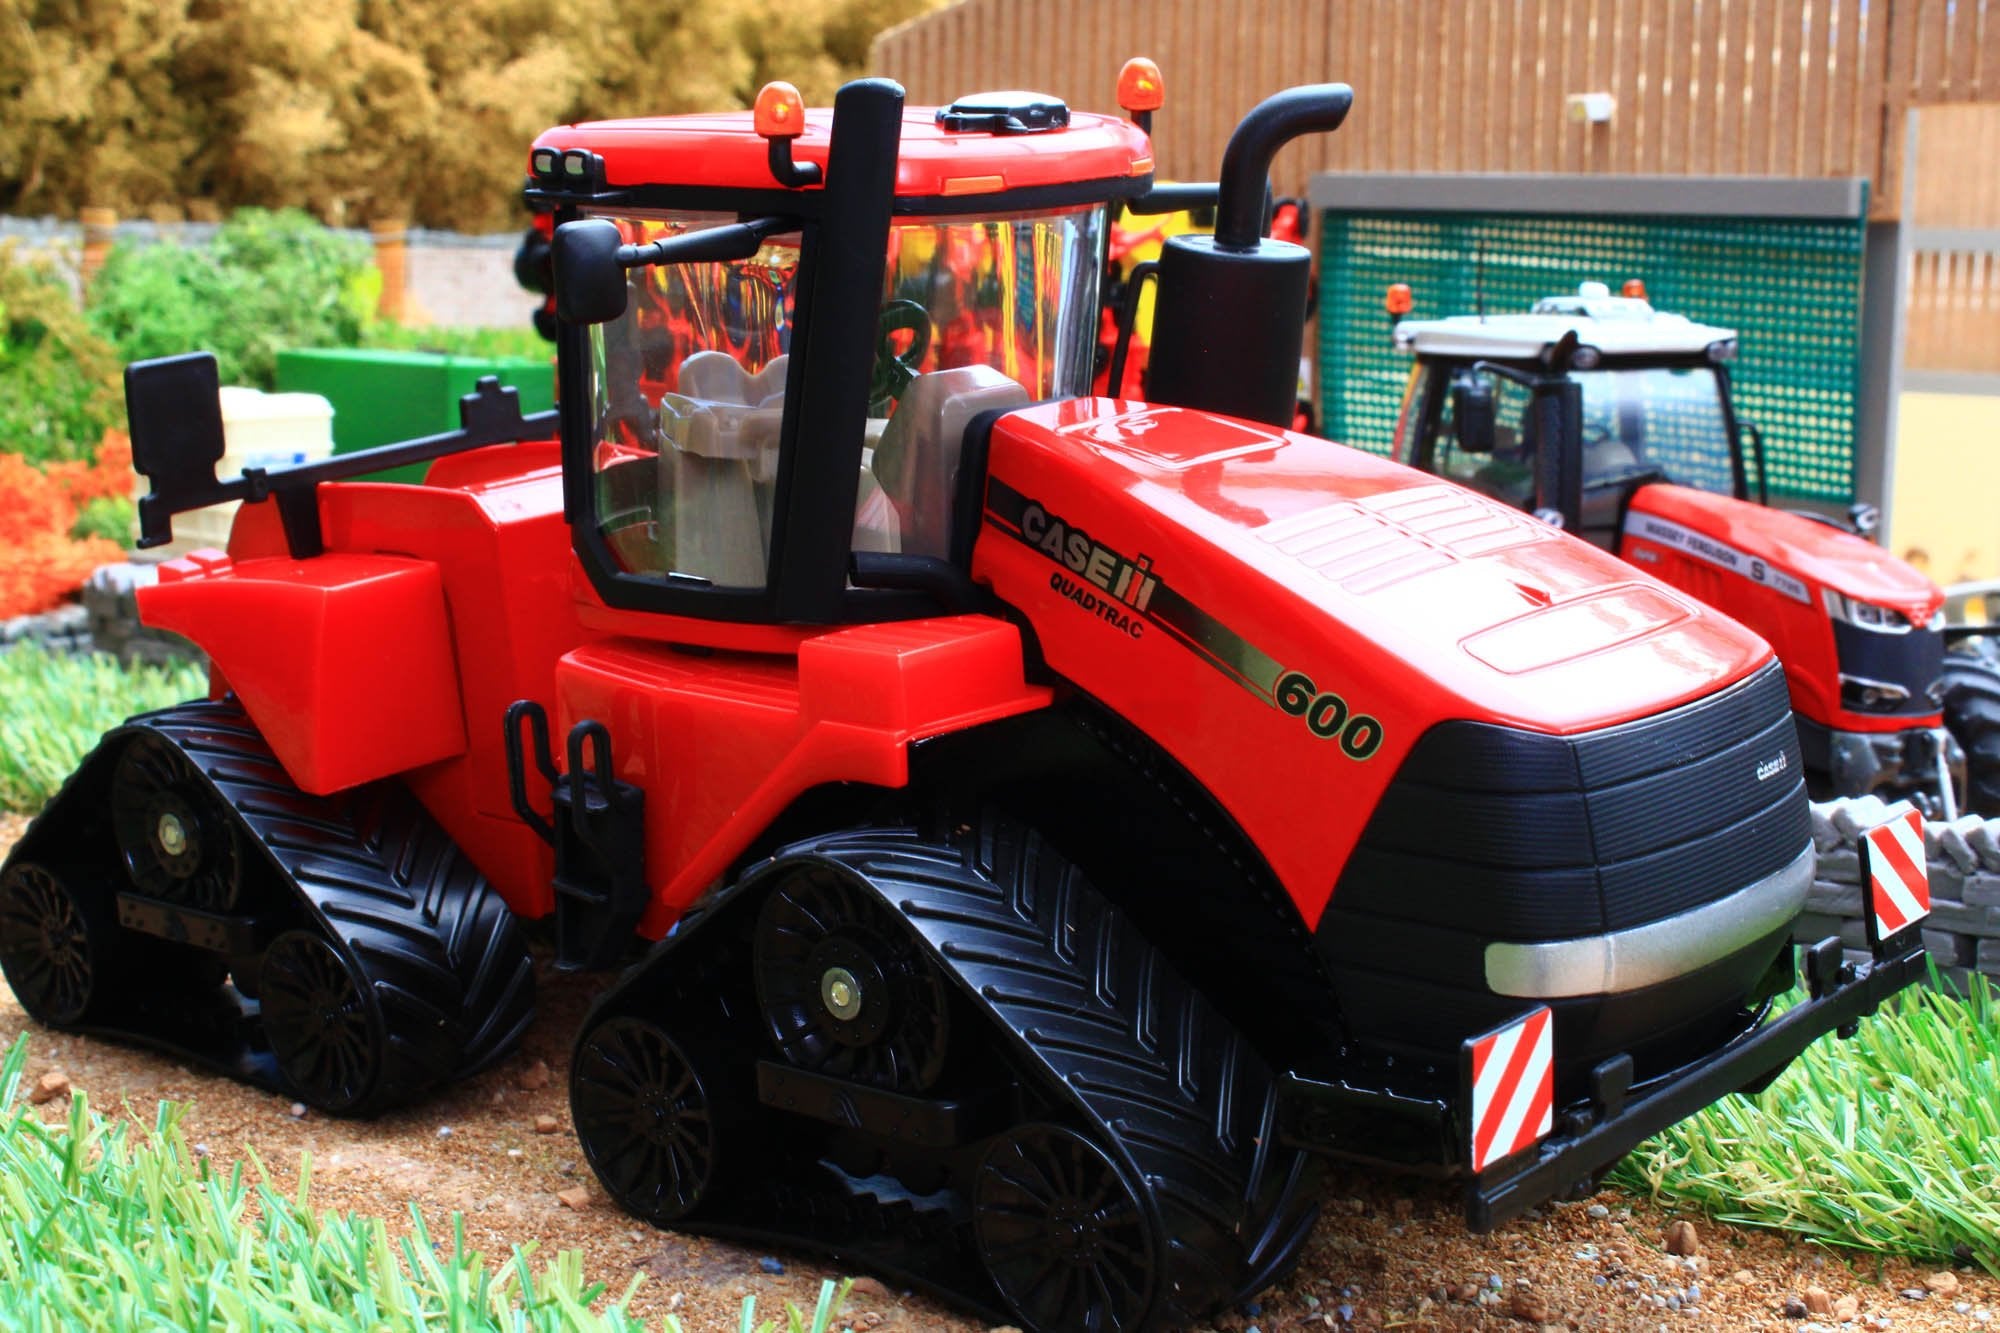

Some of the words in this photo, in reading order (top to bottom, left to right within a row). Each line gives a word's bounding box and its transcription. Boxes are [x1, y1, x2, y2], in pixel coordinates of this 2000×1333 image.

[1022, 505, 1116, 591] CASE
[1646, 521, 1684, 543] MASSEY
[1687, 535, 1736, 565] FERGUSON
[1751, 560, 1765, 581] S
[1050, 572, 1144, 639] QUADTRAC
[1275, 670, 1384, 761] 600
